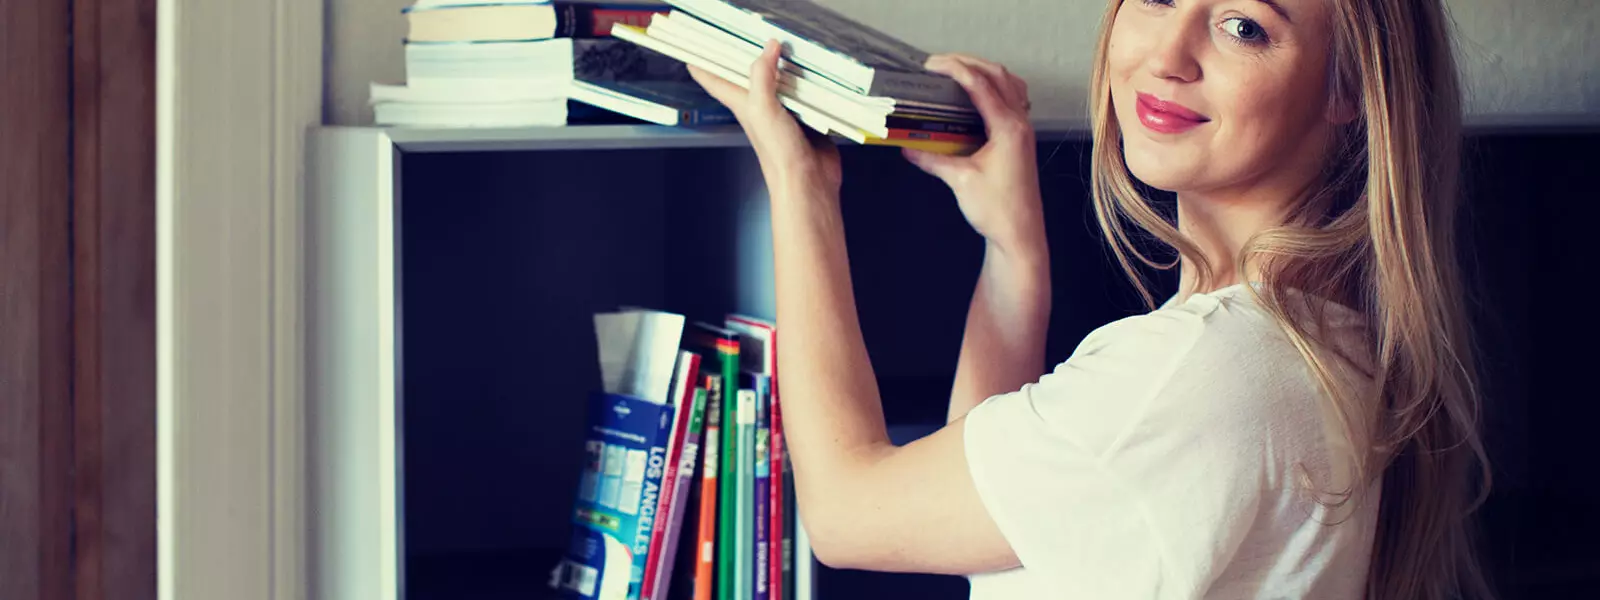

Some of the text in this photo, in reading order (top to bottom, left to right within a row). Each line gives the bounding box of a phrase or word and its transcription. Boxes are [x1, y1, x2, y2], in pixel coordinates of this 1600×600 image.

[648, 447, 665, 479] LOS
[681, 443, 698, 476] NICE
[633, 480, 659, 555] ANGELES
